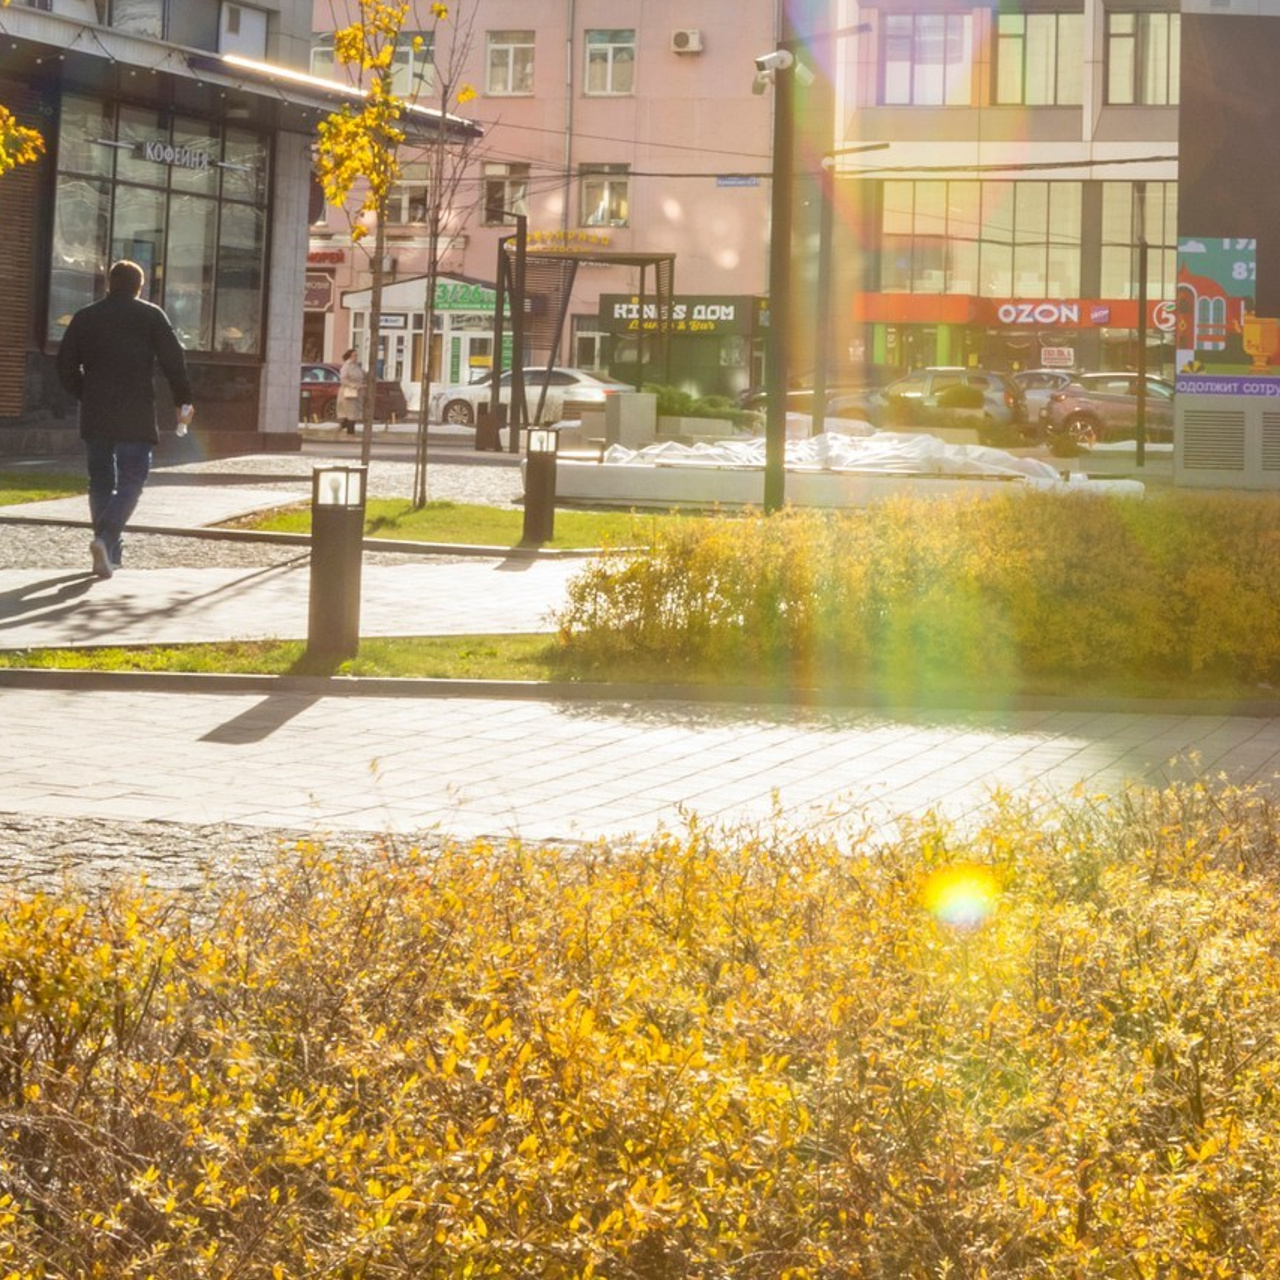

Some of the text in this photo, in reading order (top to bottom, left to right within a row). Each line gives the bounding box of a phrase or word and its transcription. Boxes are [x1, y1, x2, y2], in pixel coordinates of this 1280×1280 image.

[146, 141, 209, 170] КОФЕЙНЯ
[614, 301, 687, 319] KIN'S
[998, 304, 1079, 324] OZON
[1177, 380, 1238, 393] одолжит
